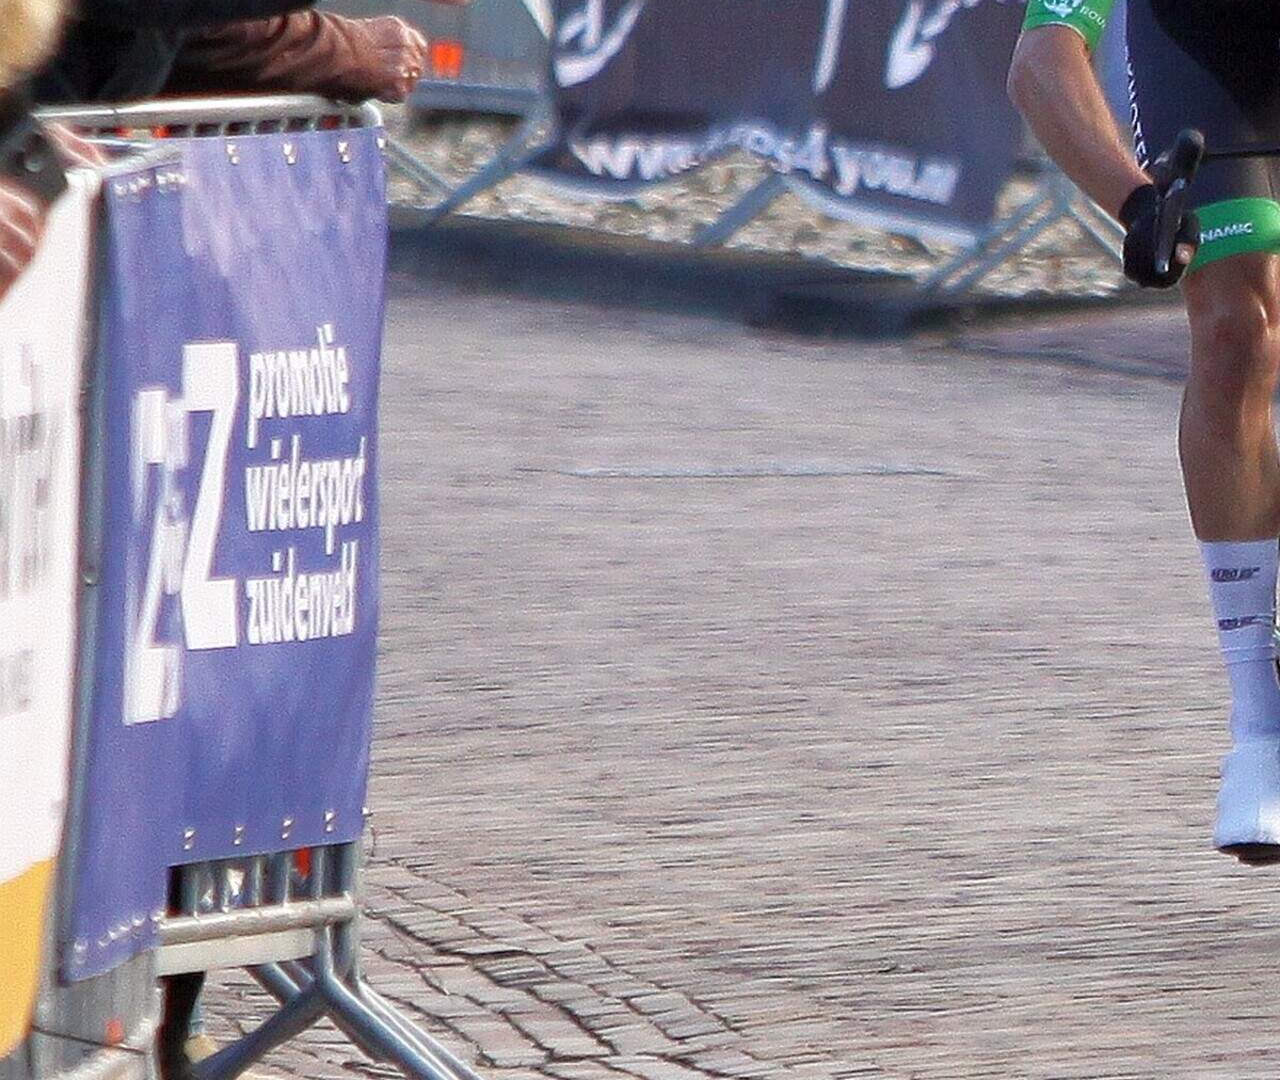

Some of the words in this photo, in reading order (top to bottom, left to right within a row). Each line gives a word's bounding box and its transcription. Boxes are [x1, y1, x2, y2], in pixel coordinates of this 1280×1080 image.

[1200, 222, 1254, 245] NAMIC
[247, 323, 350, 449] promotie
[245, 433, 367, 557] wielersport
[246, 540, 359, 646] zuidenveld
